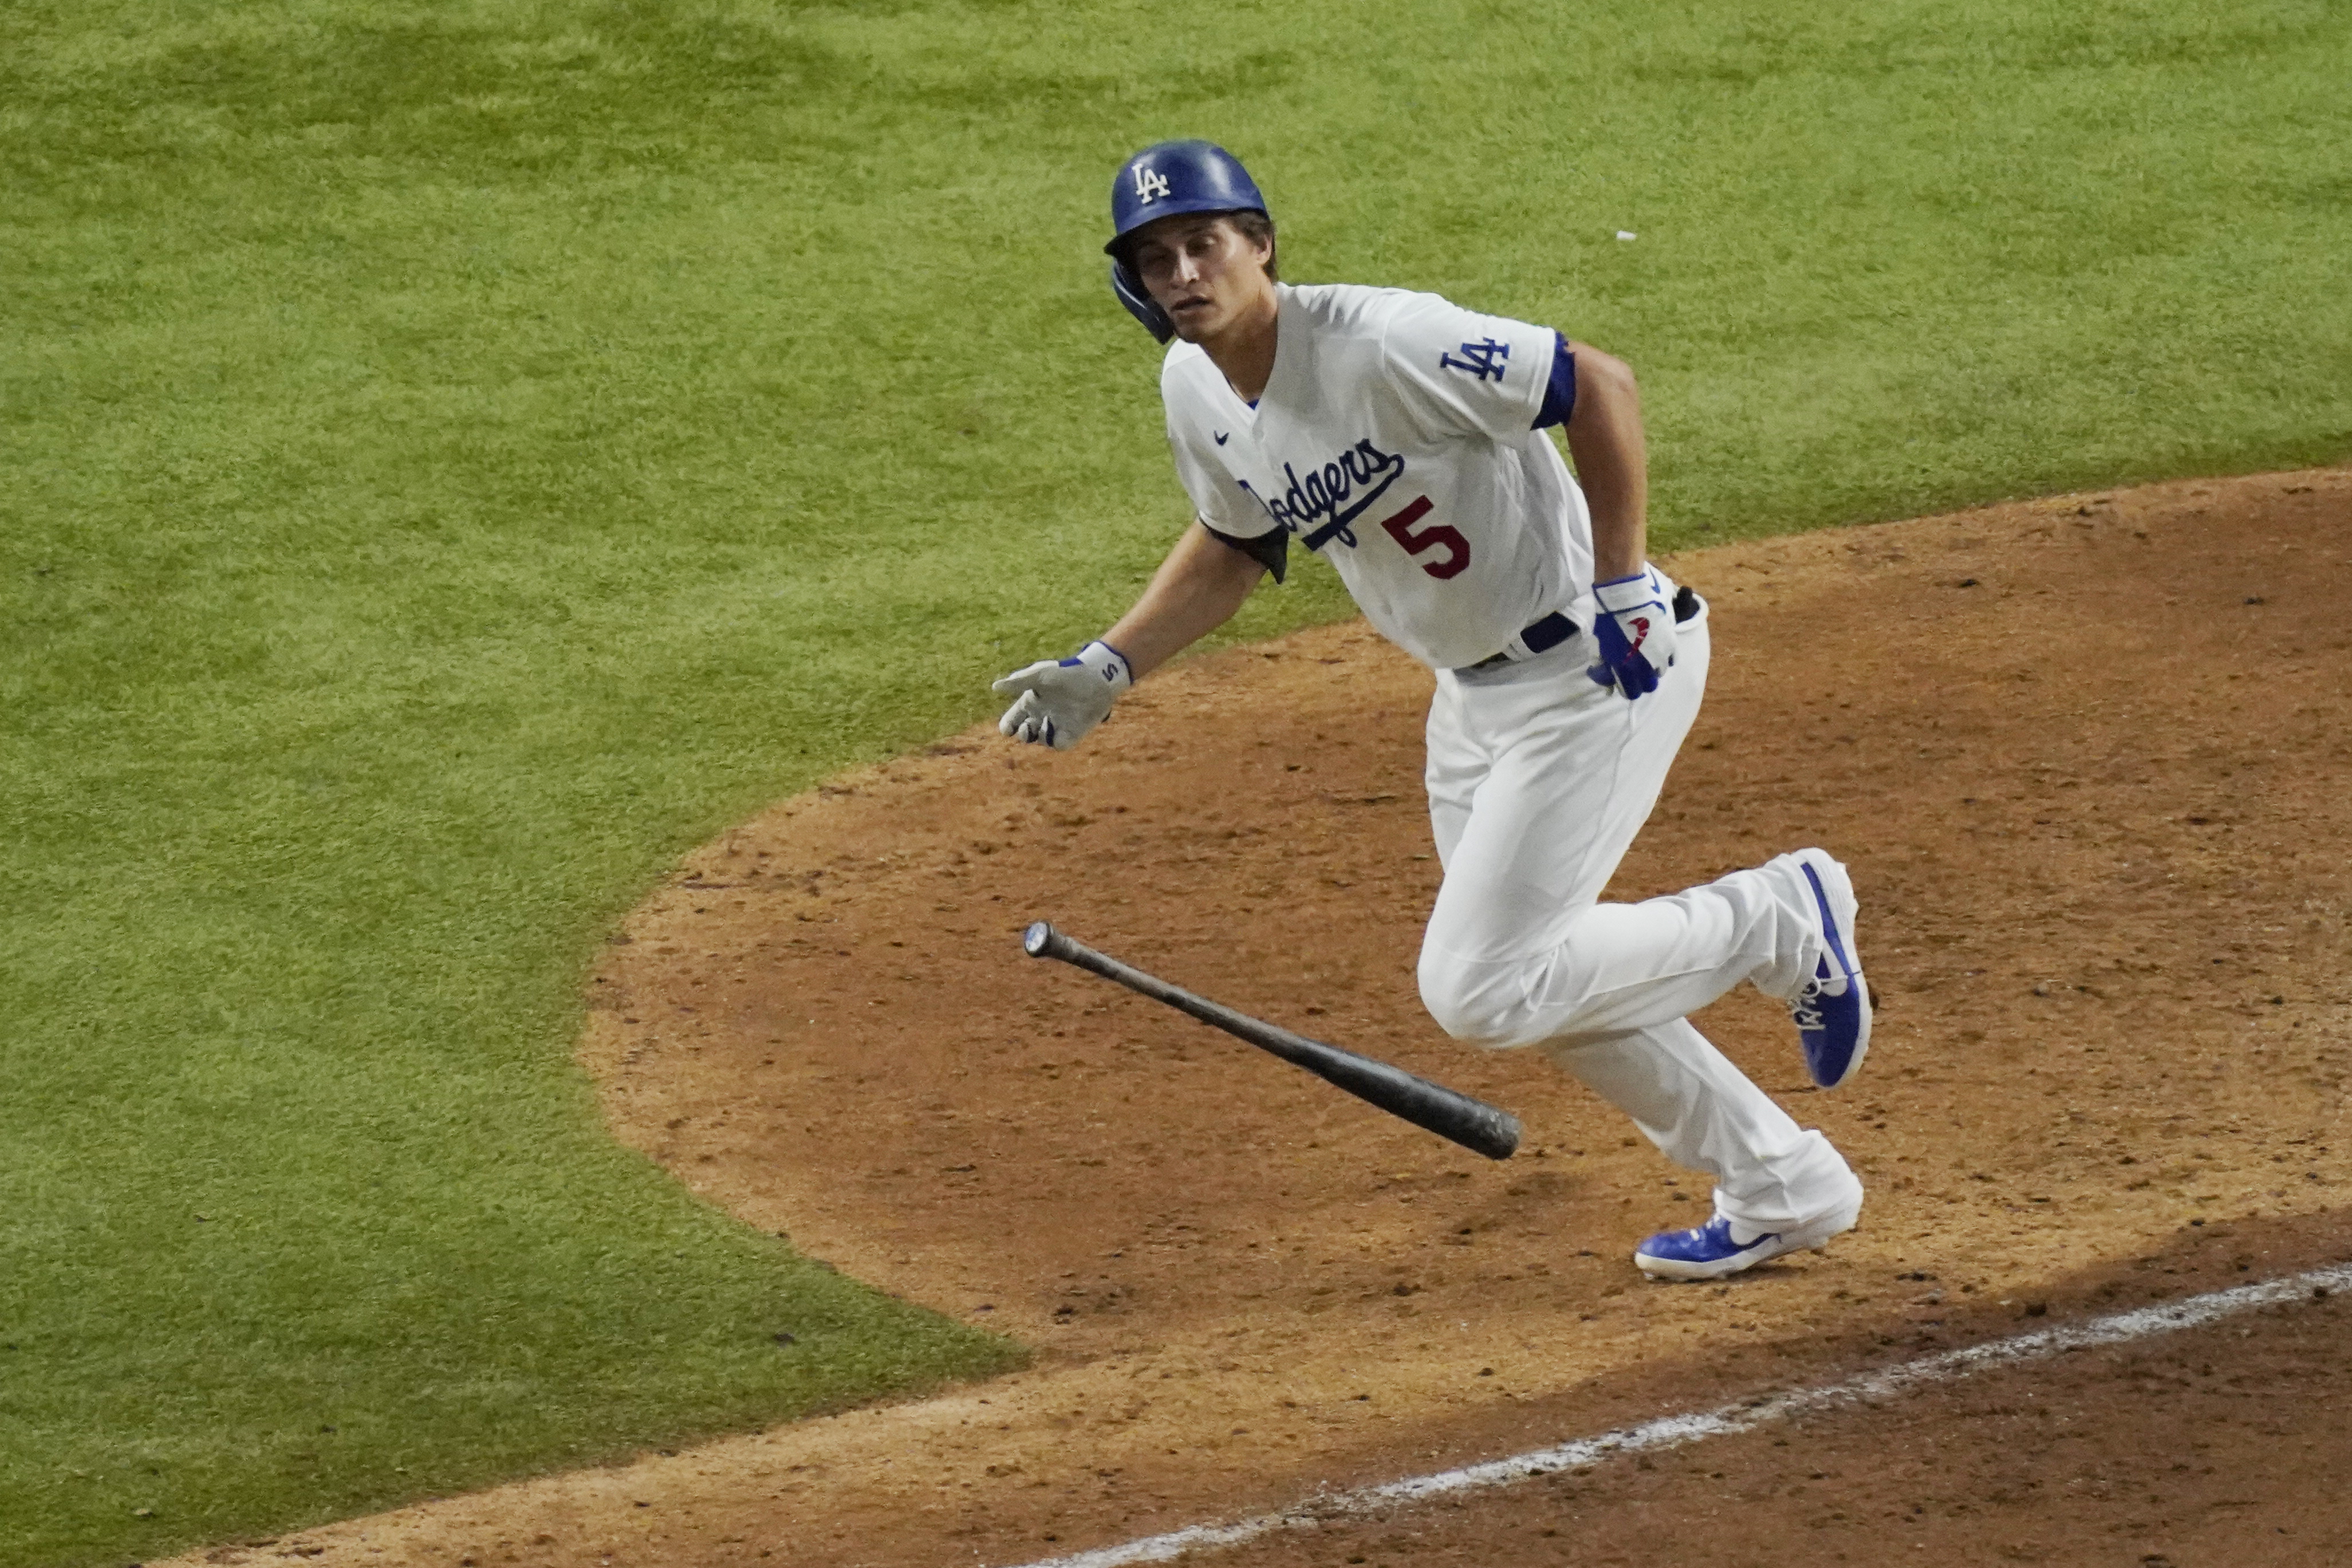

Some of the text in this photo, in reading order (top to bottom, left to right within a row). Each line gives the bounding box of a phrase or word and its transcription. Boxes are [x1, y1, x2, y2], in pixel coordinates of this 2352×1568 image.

[1132, 163, 1171, 203] LA
[1440, 337, 1510, 382] LA
[1381, 495, 1470, 580] 5
